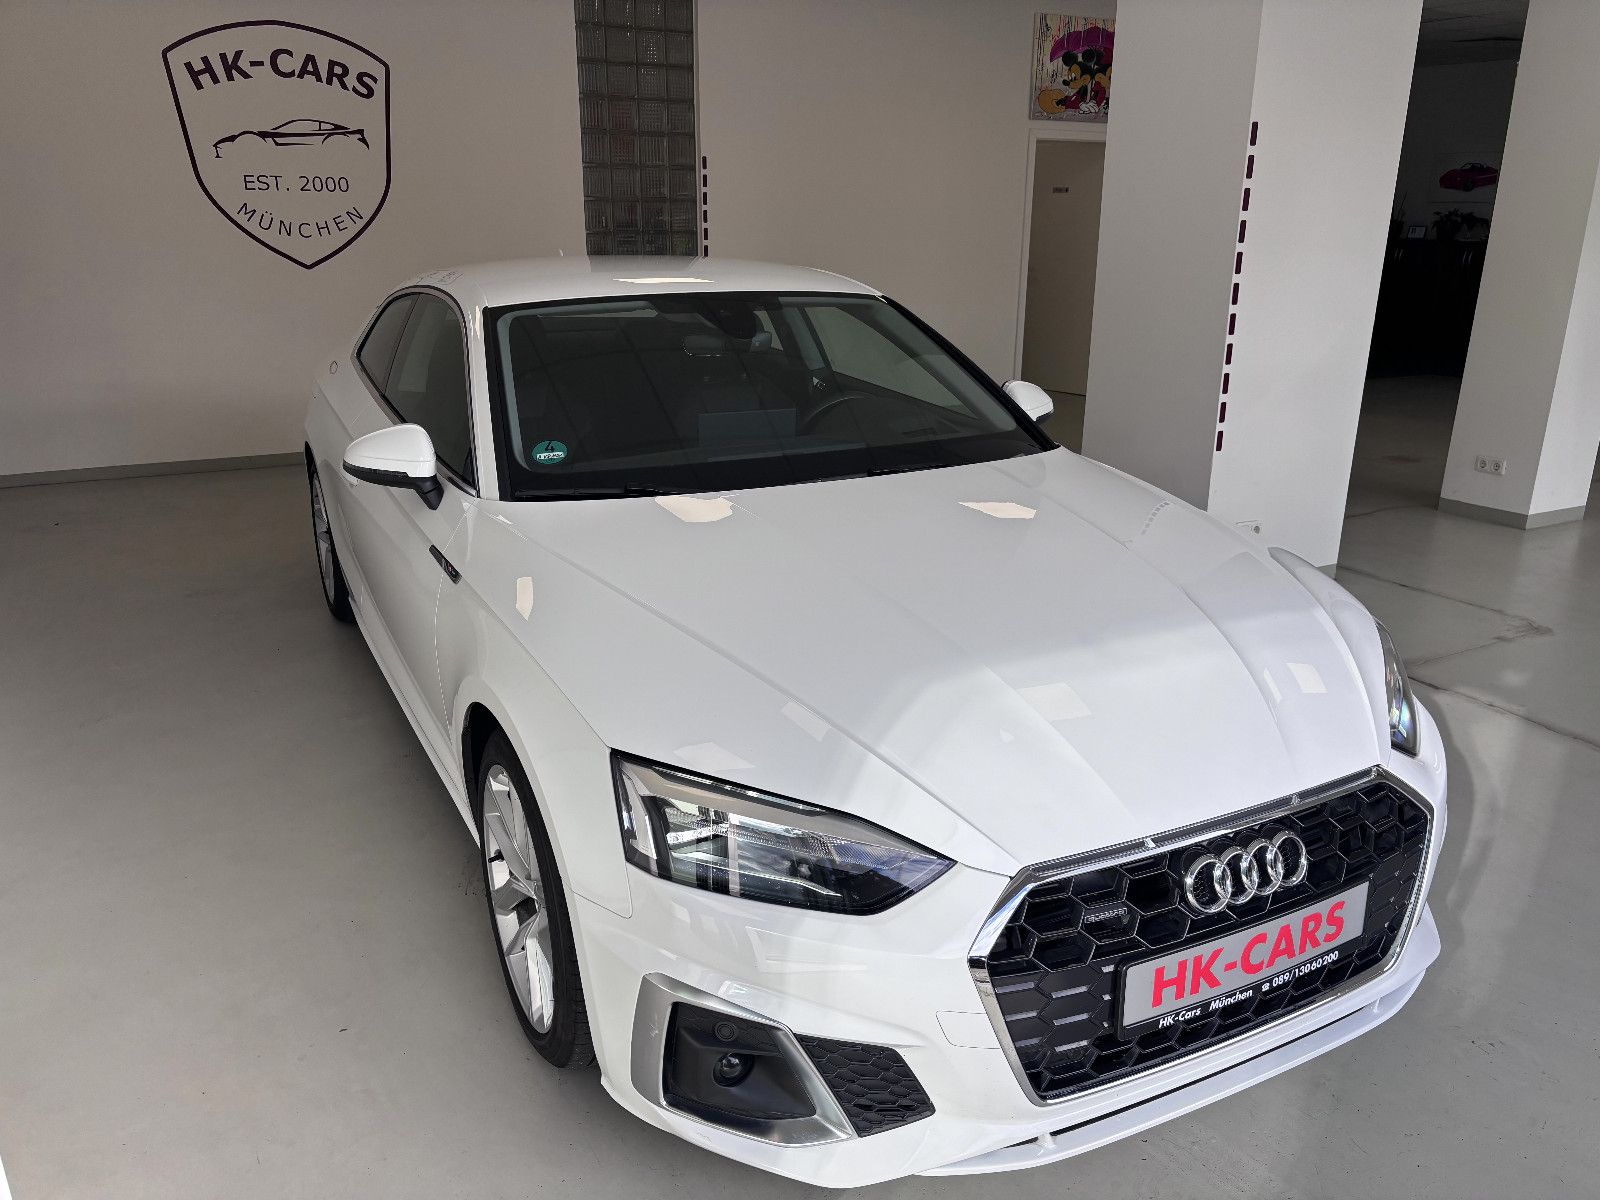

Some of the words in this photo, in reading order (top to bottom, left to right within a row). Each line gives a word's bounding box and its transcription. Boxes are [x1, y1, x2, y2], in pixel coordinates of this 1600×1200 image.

[183, 48, 379, 100] HK-CARS
[243, 174, 290, 192] EST.
[299, 175, 349, 193] 2000
[237, 202, 364, 239] MÜNCHEN
[545, 440, 555, 452] 4
[1151, 900, 1346, 1009] HK-CARS
[1158, 1007, 1201, 1028] HK-Cars
[1209, 989, 1253, 1012] München
